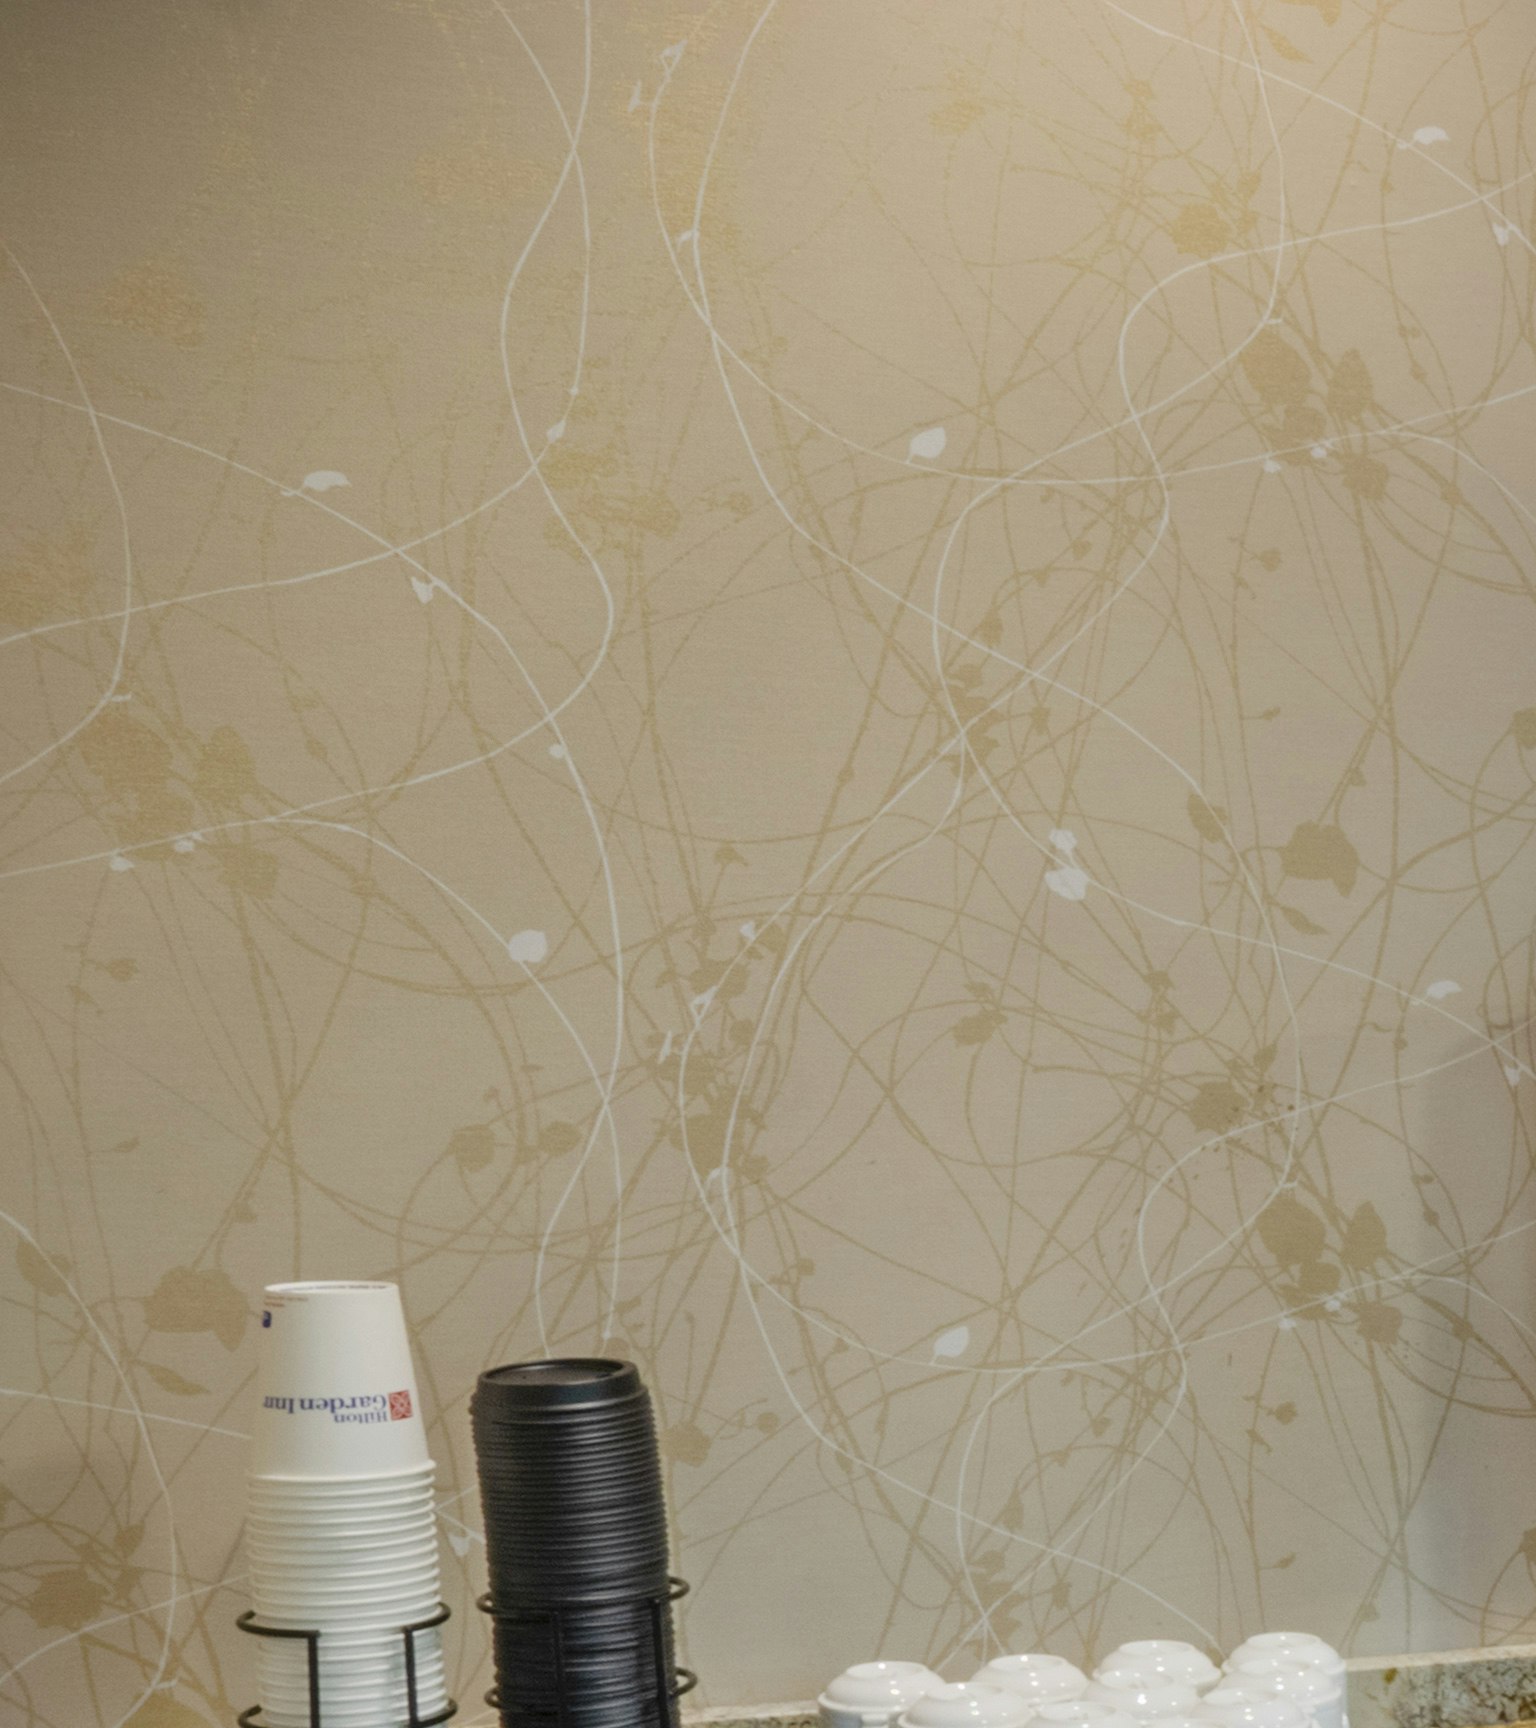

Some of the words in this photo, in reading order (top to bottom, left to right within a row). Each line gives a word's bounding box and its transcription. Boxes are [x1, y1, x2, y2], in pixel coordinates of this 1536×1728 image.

[262, 1395, 294, 1414] Inn
[300, 1394, 388, 1414] Garden
[333, 1411, 388, 1424] Hilton
